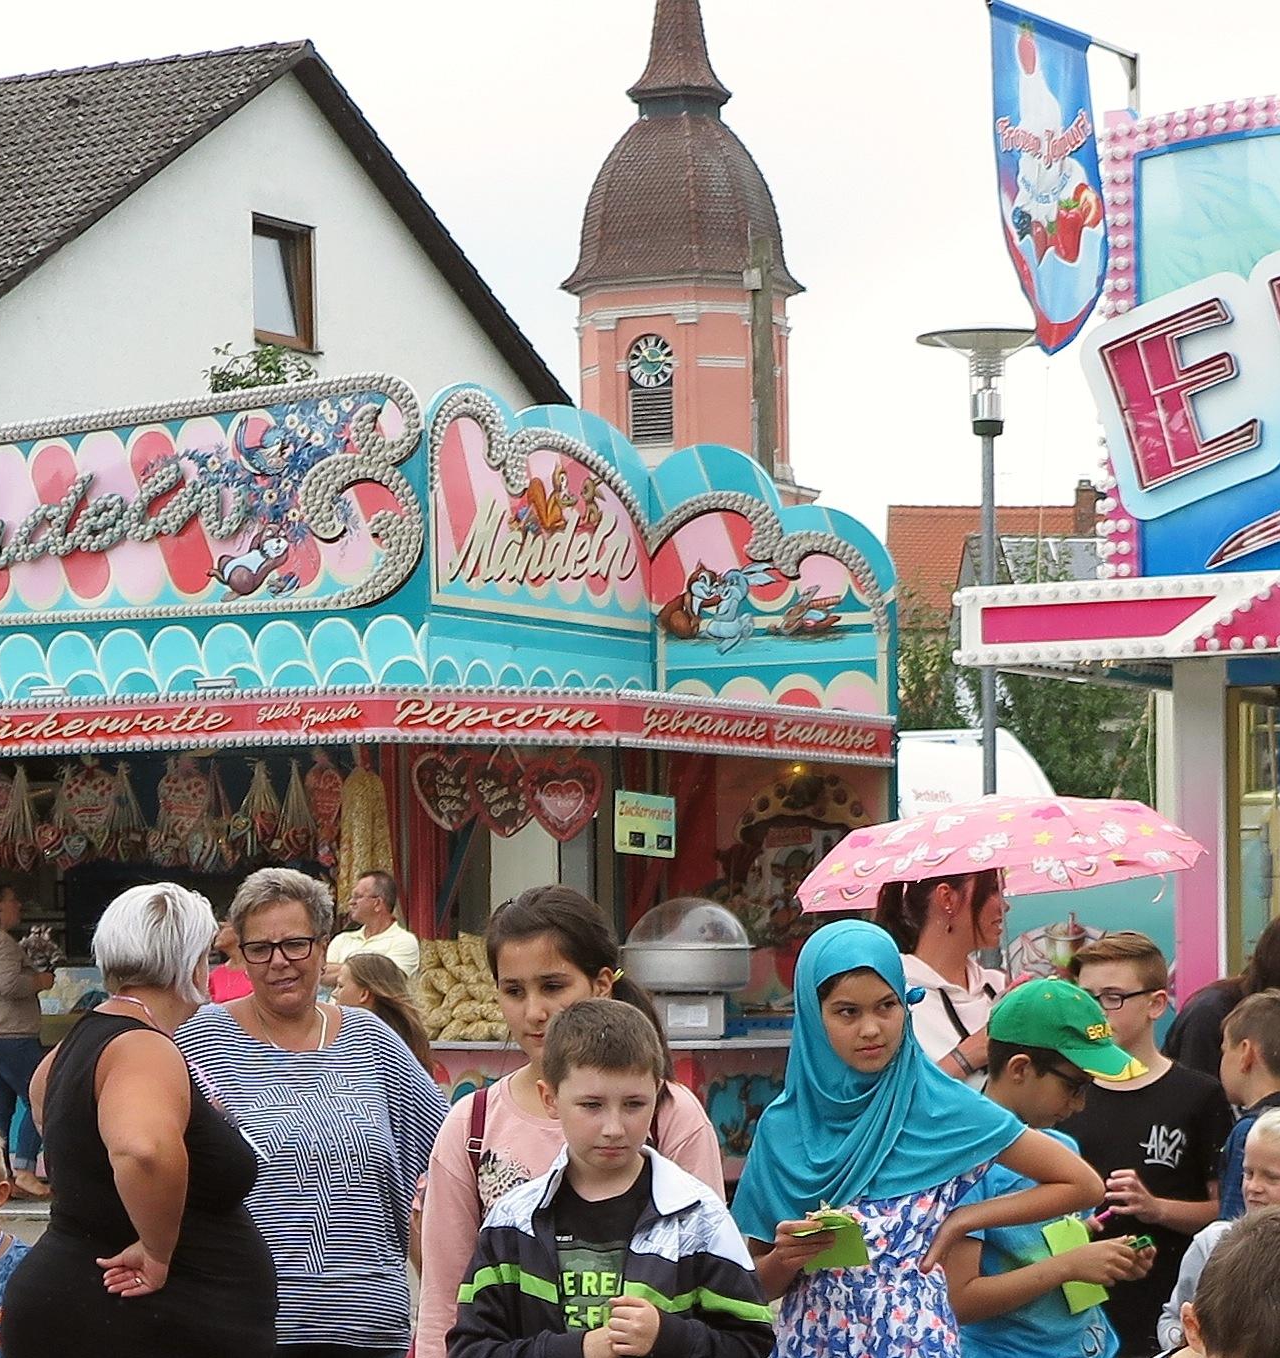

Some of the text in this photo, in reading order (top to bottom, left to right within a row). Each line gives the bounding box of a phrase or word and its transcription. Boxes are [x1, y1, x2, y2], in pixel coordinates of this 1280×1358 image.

[448, 498, 639, 584] Mandeln
[301, 702, 364, 731] frisch
[392, 698, 604, 731] Popcorn
[641, 705, 877, 751] Gebrannte Erdnüsse
